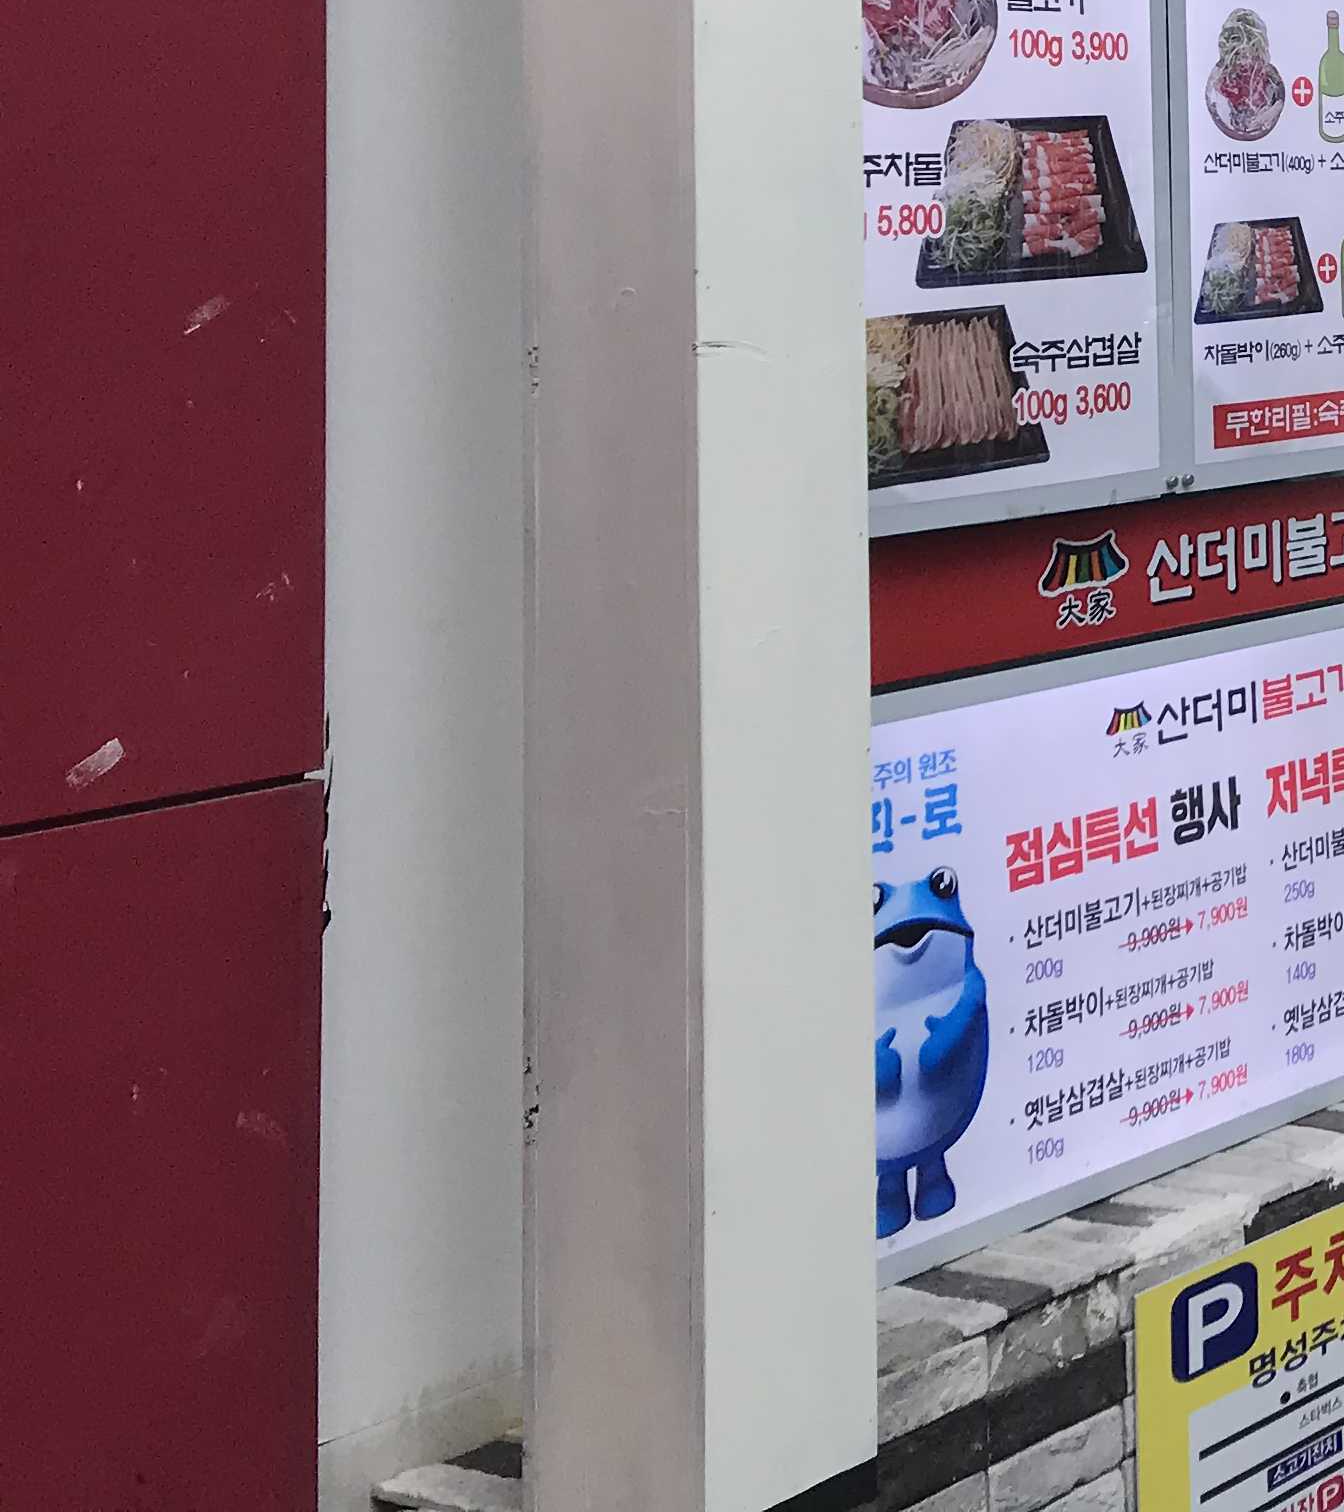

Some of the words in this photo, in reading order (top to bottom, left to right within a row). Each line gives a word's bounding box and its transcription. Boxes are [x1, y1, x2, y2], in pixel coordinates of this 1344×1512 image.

[1009, 28, 1064, 67] 100g
[1071, 30, 1129, 65] 3,900
[1324, 110, 1344, 124] 소주
[863, 151, 944, 189] 주차돌
[877, 202, 943, 242] 5,800
[1012, 330, 1143, 374] 숙주삼겹살
[1014, 389, 1068, 426] 100g
[1076, 380, 1131, 420] 3,600
[1056, 589, 1117, 630] 大家
[871, 756, 912, 789] 주의
[917, 748, 957, 779] 원조
[1005, 796, 1159, 893] 점심특선
[1169, 775, 1241, 846] 행사
[1283, 880, 1316, 904] 250g
[1197, 895, 1249, 931] 7,900원
[1025, 957, 1064, 985] 200g
[1285, 960, 1317, 986] 140g
[1198, 979, 1249, 1016] 7,900원
[1026, 1047, 1065, 1075] 120g
[1284, 1041, 1315, 1068] 180g
[1198, 1063, 1249, 1101] 7,900원
[1027, 1137, 1065, 1166] 160g
[1187, 1281, 1244, 1377] P
